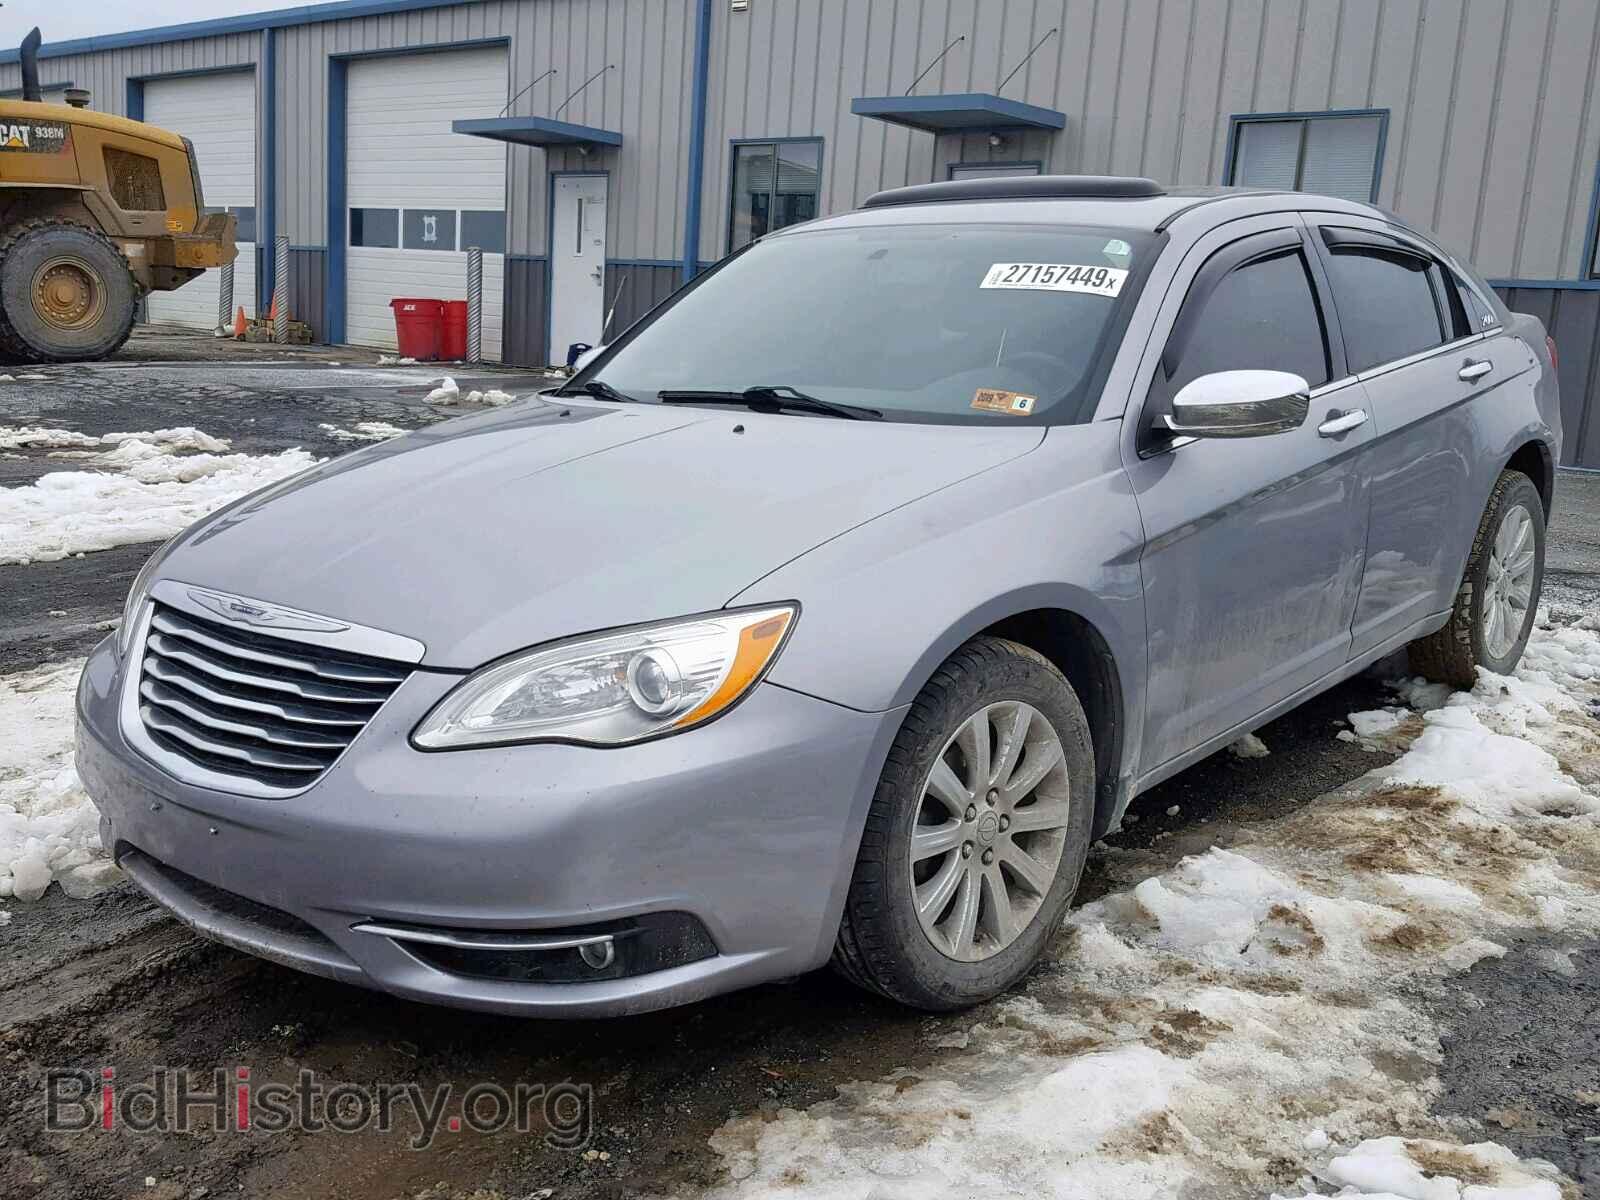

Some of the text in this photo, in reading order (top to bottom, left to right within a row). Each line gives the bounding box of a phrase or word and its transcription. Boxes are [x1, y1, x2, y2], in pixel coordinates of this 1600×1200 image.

[0, 124, 64, 147] CAT 938M
[1019, 399, 1027, 408] 6
